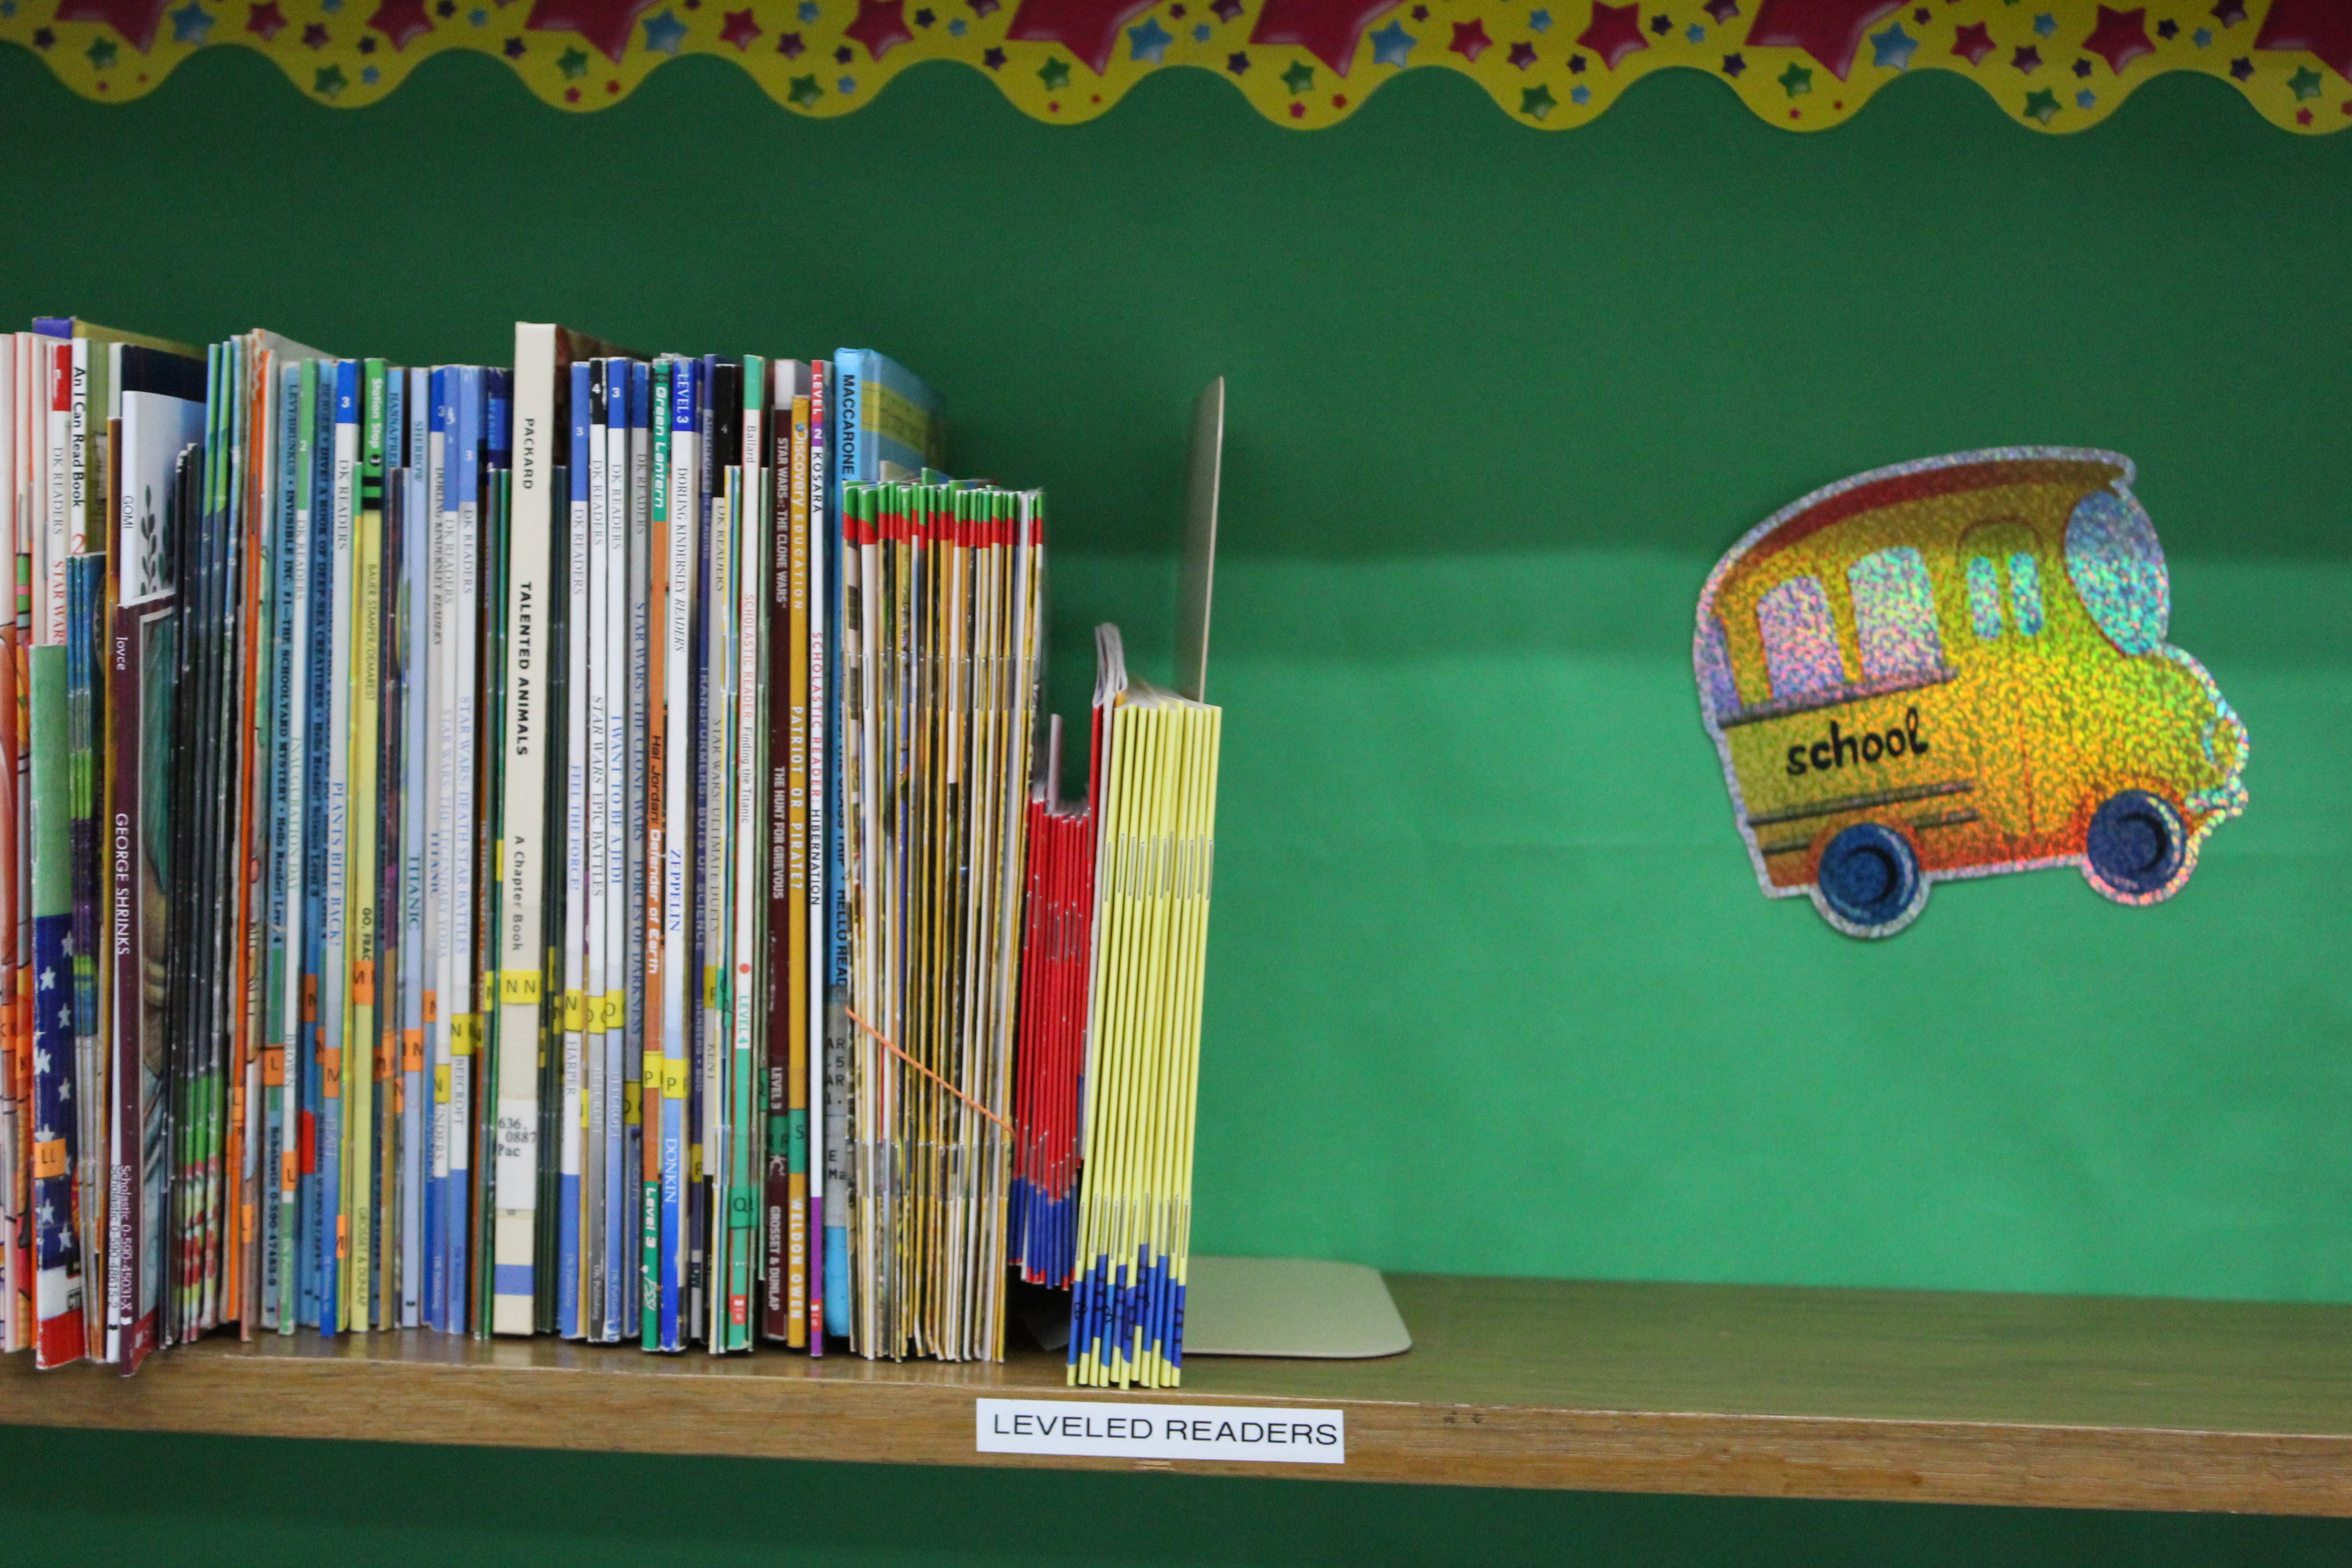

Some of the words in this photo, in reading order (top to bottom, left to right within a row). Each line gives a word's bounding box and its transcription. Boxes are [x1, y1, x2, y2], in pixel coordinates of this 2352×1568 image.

[74, 367, 86, 386] An
[612, 387, 621, 398] 3
[677, 374, 689, 413] LEVEL
[813, 374, 822, 415] LEVEL
[73, 402, 85, 428] Can
[341, 396, 350, 408] 3
[371, 378, 382, 419] Station
[654, 386, 667, 437] Green
[369, 423, 381, 449] Stop
[746, 425, 756, 463] Ballard
[842, 375, 855, 475] MACCARONE
[52, 447, 63, 466] DK
[72, 434, 85, 467] Read
[339, 460, 350, 479] DK
[413, 421, 423, 483] SHERROW
[523, 418, 535, 489] PACKARD
[592, 460, 603, 479] DK
[636, 454, 645, 474] DK
[778, 438, 789, 465] STAR
[792, 429, 809, 507] Discovery
[72, 472, 85, 507] Book
[434, 467, 443, 519] DORLING
[612, 464, 621, 483] DK
[653, 441, 667, 508] Lantern
[676, 468, 688, 519] DORLING
[812, 453, 822, 513] KOSARA
[52, 472, 64, 534] READERS
[123, 495, 134, 529] GOMI
[285, 489, 296, 556] INVISIBLE
[337, 487, 349, 550] READERS
[463, 510, 472, 528] DK
[573, 508, 584, 528] DK
[592, 486, 603, 546] READERS
[611, 490, 622, 550] READERS
[636, 477, 645, 534] READERS
[716, 505, 725, 525] DK
[777, 510, 788, 531] THE
[297, 519, 306, 539] DK
[445, 519, 453, 540] DK
[776, 533, 788, 568] CLONE
[295, 543, 305, 600] READERS
[434, 522, 443, 589] KINDERSLEY
[444, 544, 454, 605] READERS
[462, 534, 472, 594] READERS
[572, 533, 584, 595] READERS
[675, 524, 688, 593] KINDERSLEY
[715, 530, 724, 592] READERS
[794, 514, 803, 610] EDUCATION
[53, 560, 65, 598] STAR
[366, 565, 376, 595] BAUER
[53, 605, 65, 645] WARS
[433, 594, 442, 645] READERS
[518, 581, 532, 669] TALENTED
[635, 602, 645, 641] STAR
[674, 598, 687, 652] READERS
[743, 594, 755, 667] SCHOLASTIC
[812, 632, 822, 728] SCHOLASTIC
[441, 708, 452, 742] STAR
[460, 696, 470, 734] STAR
[516, 677, 530, 756] ANIMALS
[591, 695, 603, 735] STAR
[635, 702, 644, 733] THE
[712, 719, 722, 754] STAR
[611, 725, 621, 773] WANT
[651, 735, 661, 759] Hal
[740, 726, 753, 764] Finding
[791, 706, 804, 773] PATRIOT
[1786, 707, 1929, 775] school
[458, 739, 470, 785] WARS:
[570, 764, 581, 799] FEEL
[591, 741, 603, 785] WARS
[741, 769, 752, 785] the
[774, 766, 785, 787] THE
[332, 782, 343, 845] PLANTS
[440, 796, 451, 822] THE
[592, 792, 603, 825] EPIC
[611, 782, 621, 804] TO
[741, 788, 752, 823] Titanic
[774, 790, 785, 820] HUNT
[791, 788, 803, 808] OR
[457, 791, 469, 842] DEATH
[570, 805, 581, 833] THE
[611, 810, 621, 826] BE
[634, 800, 644, 842] WARS
[773, 823, 784, 842] FOR
[115, 813, 129, 881] GEORGE
[515, 836, 524, 844] A
[611, 834, 621, 844] A
[710, 807, 721, 879] ULTIMATE
[791, 823, 803, 890] PIRATE?
[810, 809, 820, 906] HIBERNATION
[330, 852, 343, 889] BITE
[430, 832, 440, 899] TITANIC
[438, 829, 450, 912] LEGENDARY
[457, 846, 469, 884] STAR
[512, 851, 524, 907] Chapter
[569, 838, 580, 891] FORCE!
[591, 831, 603, 897] BATTLES
[608, 848, 621, 883] JEDI
[649, 829, 661, 902] Defender
[773, 846, 784, 899] GRIEVOUS
[407, 854, 420, 931] TITANIC
[633, 860, 644, 921] FORCES
[669, 848, 682, 932] ZEPPELIN
[709, 886, 719, 932] DUELS
[116, 888, 130, 955] SHRINKS
[329, 897, 342, 946] BACK!
[361, 908, 372, 929] GO,
[437, 915, 449, 957] YODA
[456, 890, 469, 954] BATTLES
[512, 913, 523, 951] Book
[649, 907, 660, 923] of
[837, 890, 846, 940] HELLO
[648, 927, 660, 974] Earth
[506, 979, 517, 993] N
[524, 980, 535, 994] N
[738, 995, 749, 1033] LEVEL
[566, 1041, 578, 1095] HARPER
[707, 1043, 715, 1081] KENT
[771, 1067, 782, 1100] LEVEL
[454, 1059, 464, 1125] BEECROFT
[611, 1072, 620, 1139] BEECROFT
[667, 1077, 677, 1091] P
[499, 1117, 528, 1130] 636.
[497, 1143, 520, 1157] Pac
[664, 1138, 678, 1202] DONKIN
[110, 1164, 120, 1221] Scholastic
[120, 1165, 131, 1220] Scholastic
[646, 1187, 656, 1231] Level
[358, 1207, 368, 1252] GROSSET
[646, 1236, 656, 1248] 3
[769, 1206, 781, 1252] GROSSET
[790, 1197, 803, 1265] WELDON
[120, 1224, 133, 1310] 0-590-45031-X
[358, 1267, 367, 1306] DUNLAP
[768, 1267, 780, 1310] DUNLAP
[790, 1274, 803, 1319] OWEN
[993, 1413, 1153, 1440] LEVELED
[1166, 1420, 1338, 1446] READERS
